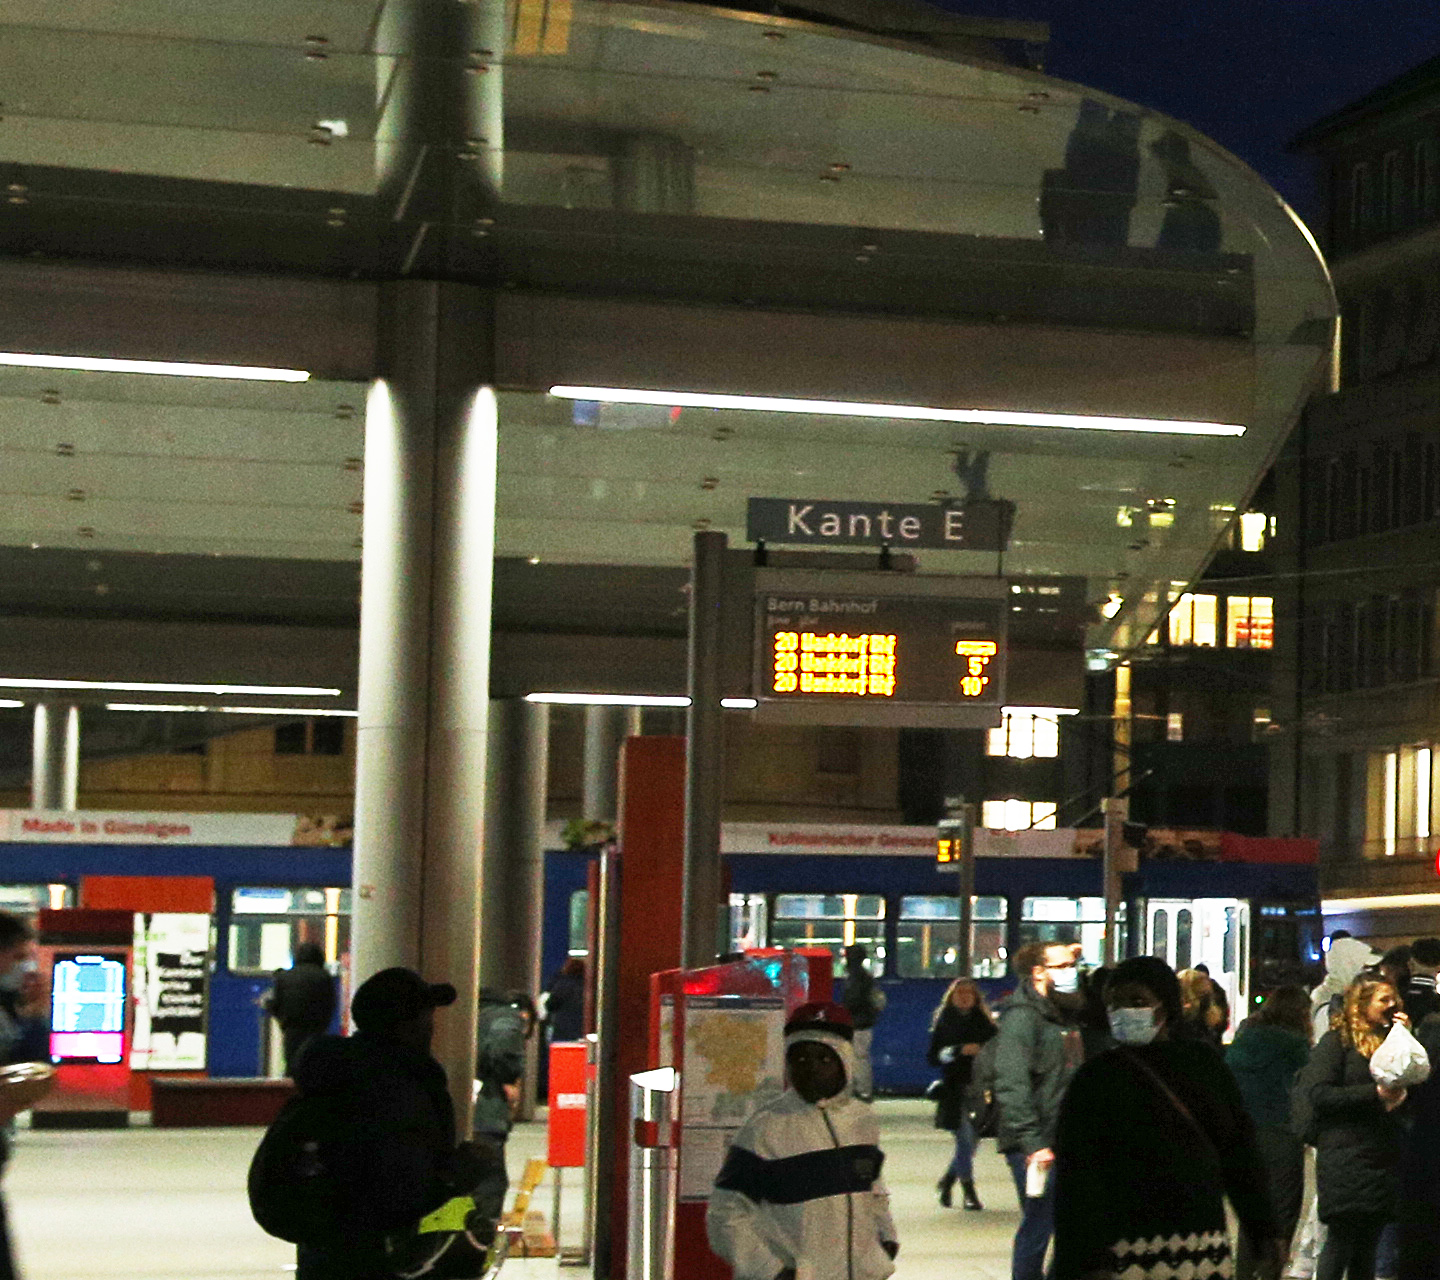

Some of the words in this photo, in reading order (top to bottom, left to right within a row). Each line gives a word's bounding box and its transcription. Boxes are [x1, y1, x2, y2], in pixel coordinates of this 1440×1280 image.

[787, 505, 921, 539] Kante
[944, 510, 964, 541] E
[767, 598, 805, 612] Bern
[809, 599, 878, 614] Bahnhof
[774, 632, 799, 652] 20
[774, 652, 799, 672] 20
[773, 672, 798, 692] 20
